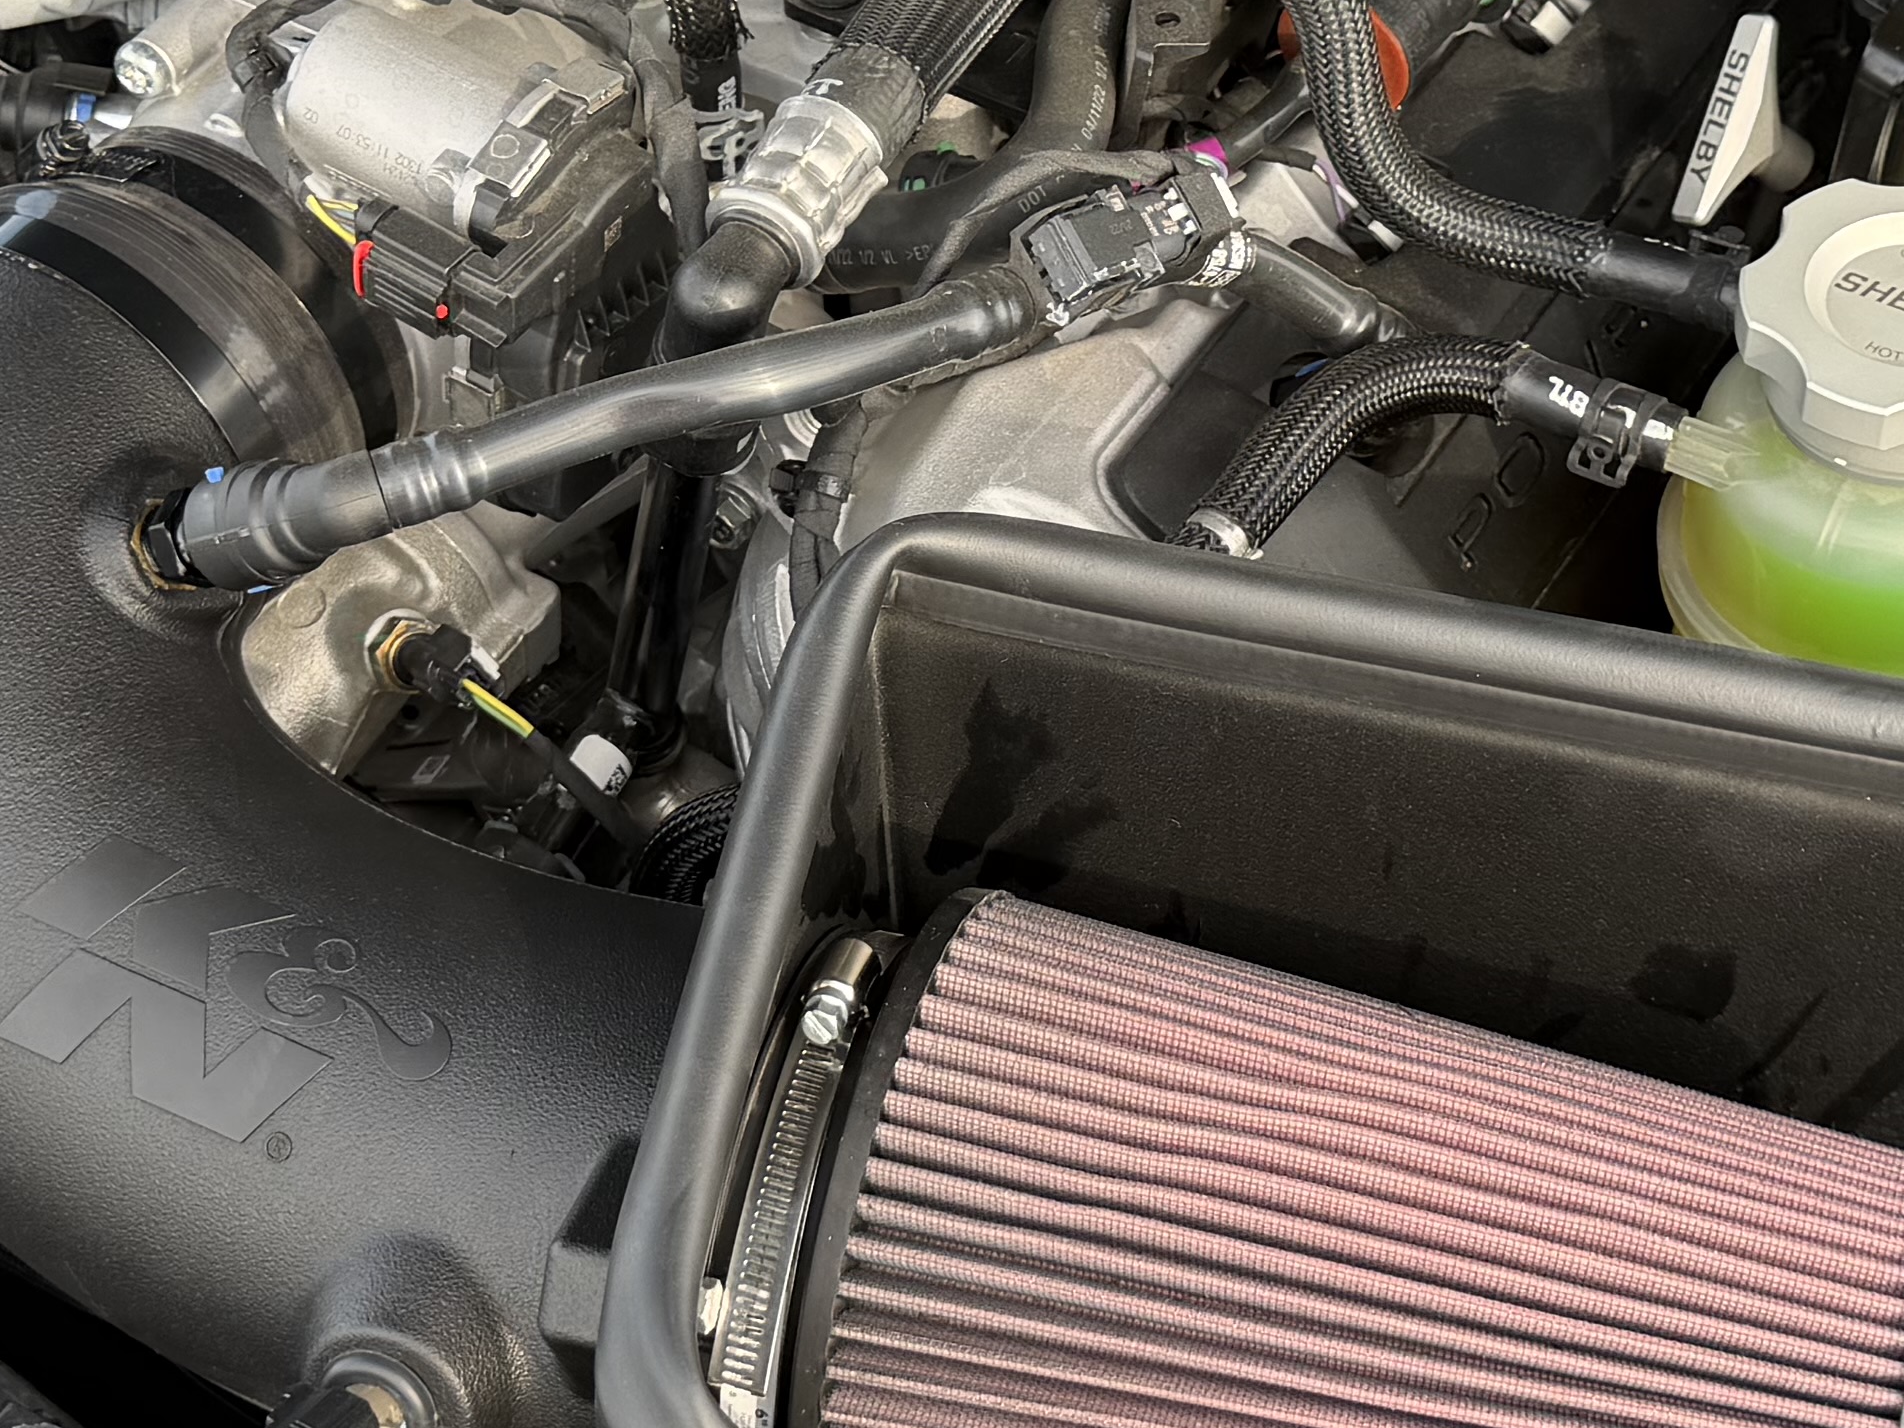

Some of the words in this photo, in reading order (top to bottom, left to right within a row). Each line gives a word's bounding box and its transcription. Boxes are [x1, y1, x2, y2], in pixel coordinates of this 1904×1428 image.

[1690, 47, 1750, 187] SHELBY
[1017, 183, 1050, 217] DOT
[1865, 339, 1904, 362] HOT
